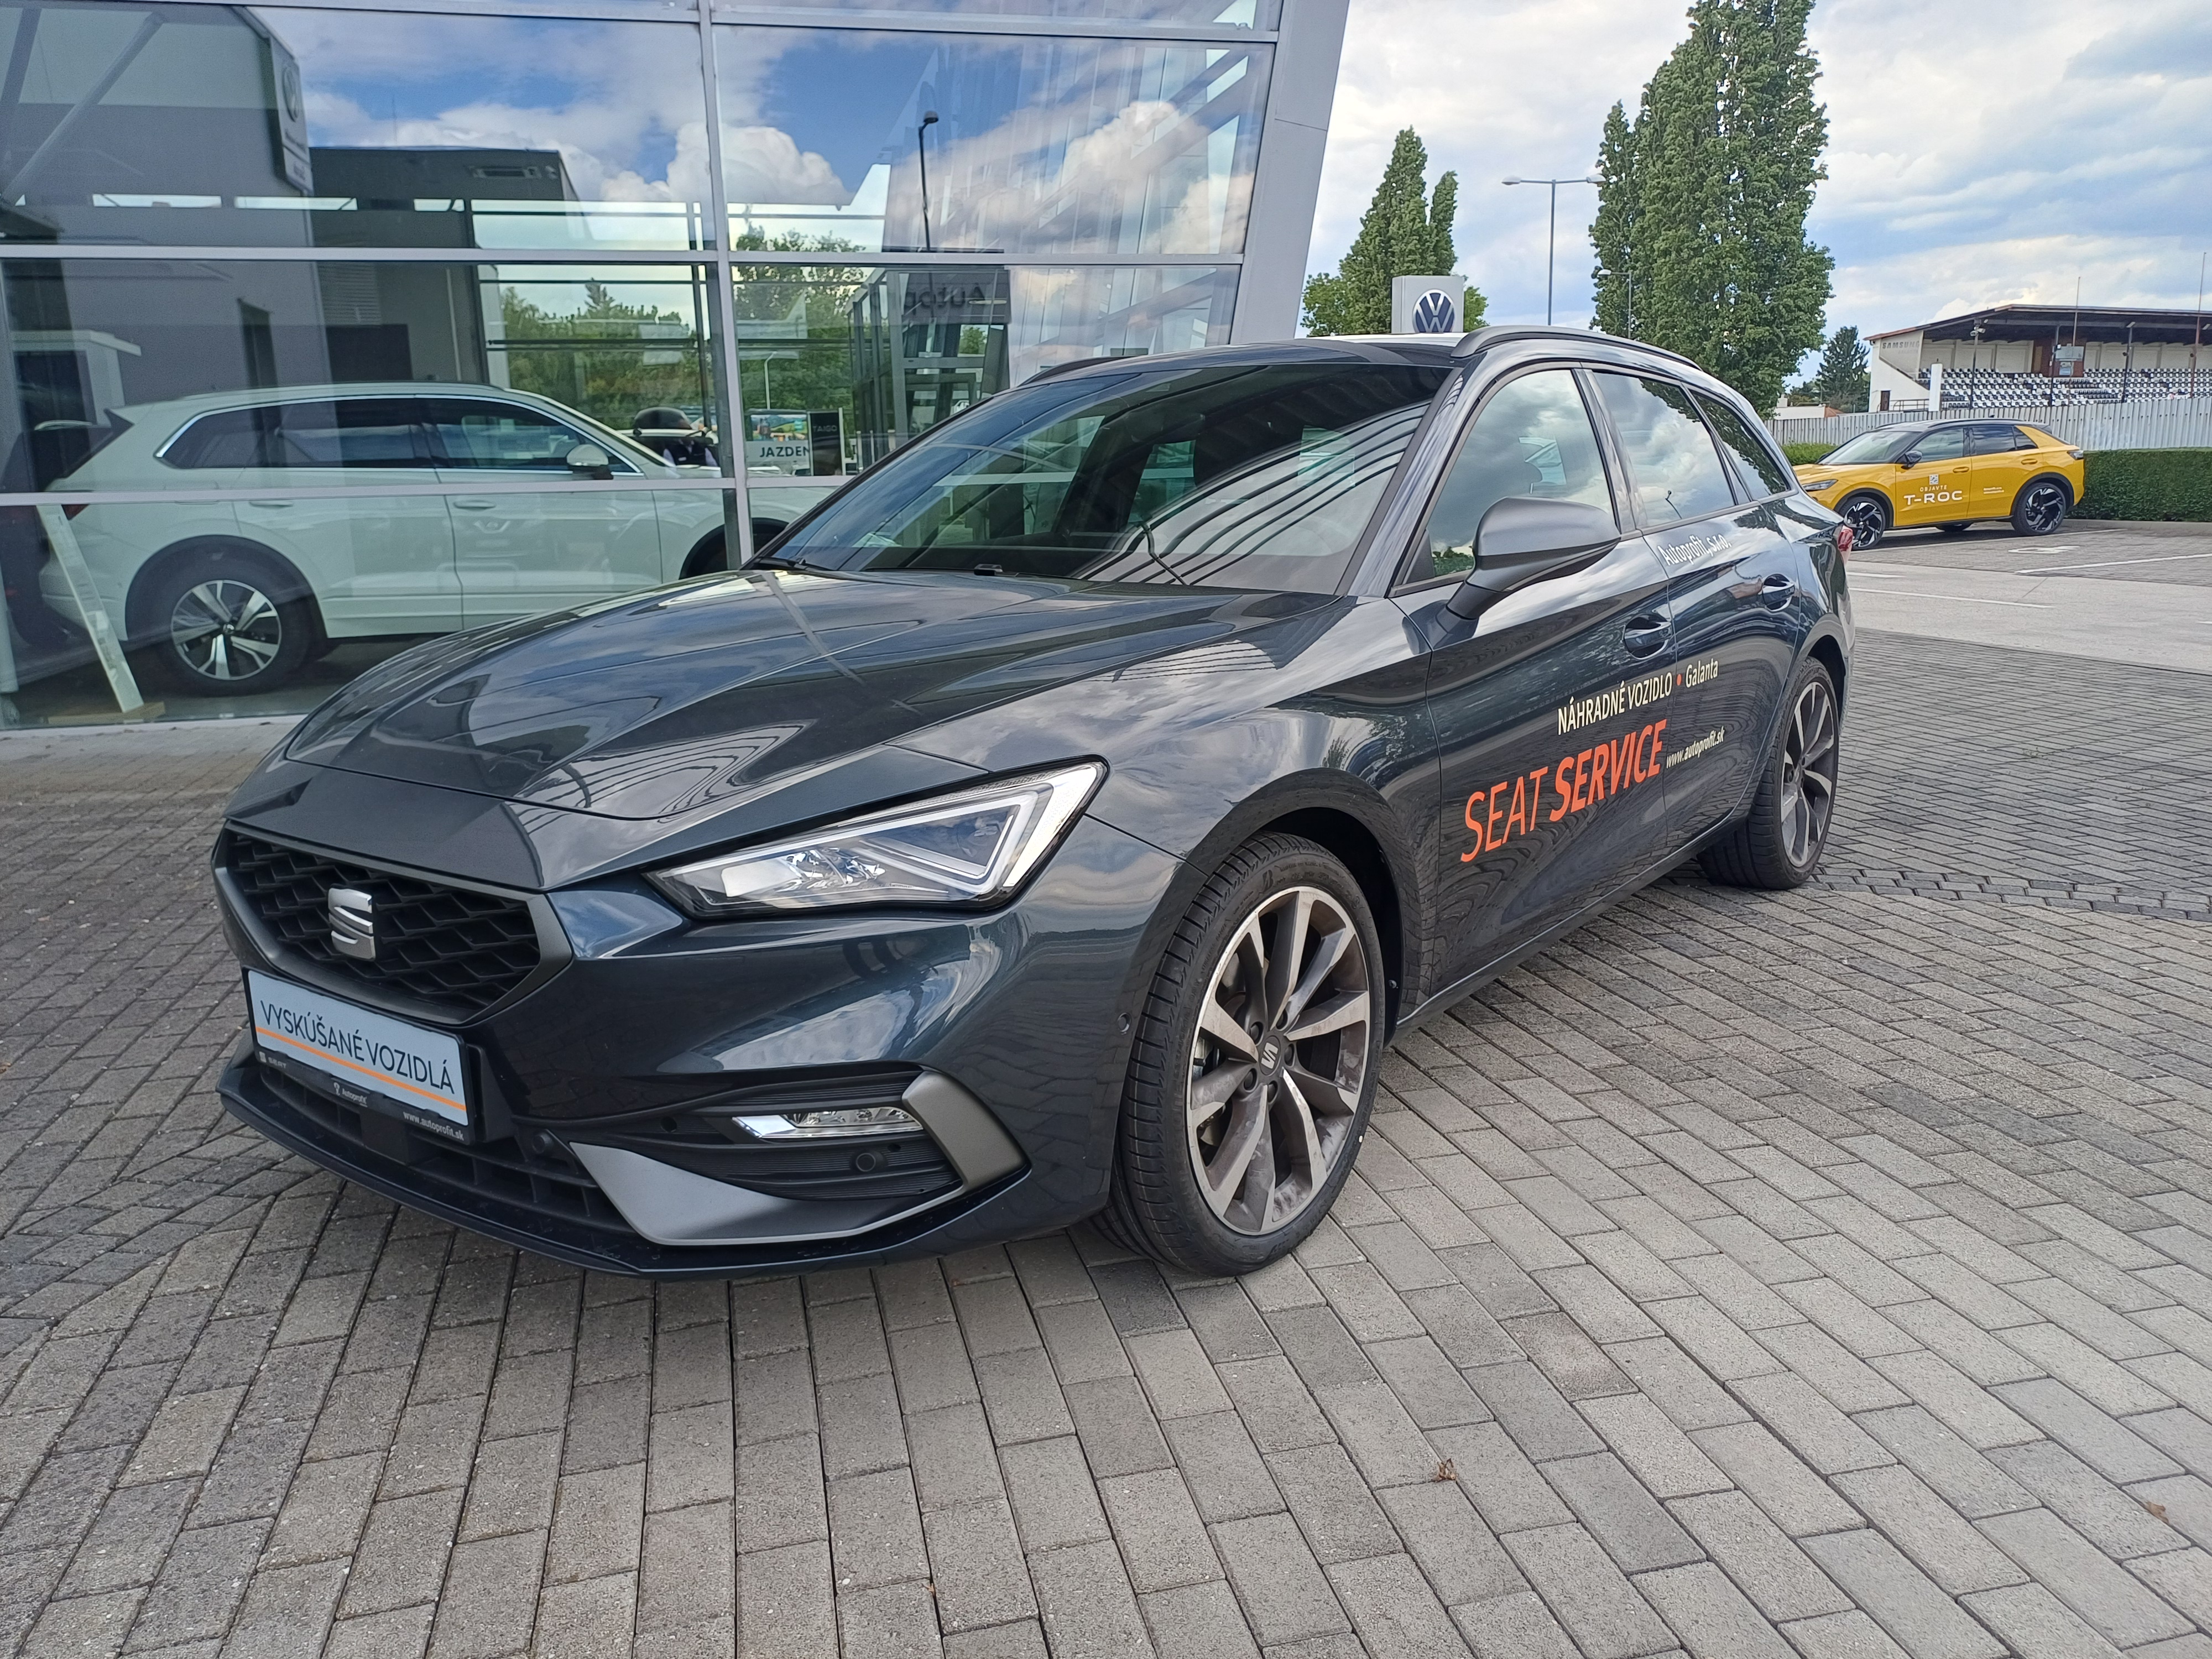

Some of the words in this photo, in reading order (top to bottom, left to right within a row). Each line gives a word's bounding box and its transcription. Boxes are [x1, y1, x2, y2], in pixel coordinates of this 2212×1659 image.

[1882, 340, 1919, 349] SAMSUNG
[1903, 490, 1963, 505] T-ROC
[1657, 535, 1714, 566] Autoprofit,
[1706, 534, 1732, 552] s.r.o.
[1558, 680, 1626, 735] NÁHRADNÉ
[1627, 672, 1673, 710] VOZIDLO
[1686, 658, 1719, 688] Galanta
[1666, 725, 1725, 769] www.autoprofit.sk
[1460, 766, 1548, 863] SEAT
[1549, 718, 1667, 822] SERVICE
[260, 1000, 365, 1062] VYSKÚŠANÉ
[365, 1039, 455, 1094] VOZIDLÁ
[403, 1111, 465, 1141] www.autoprofit.sk
